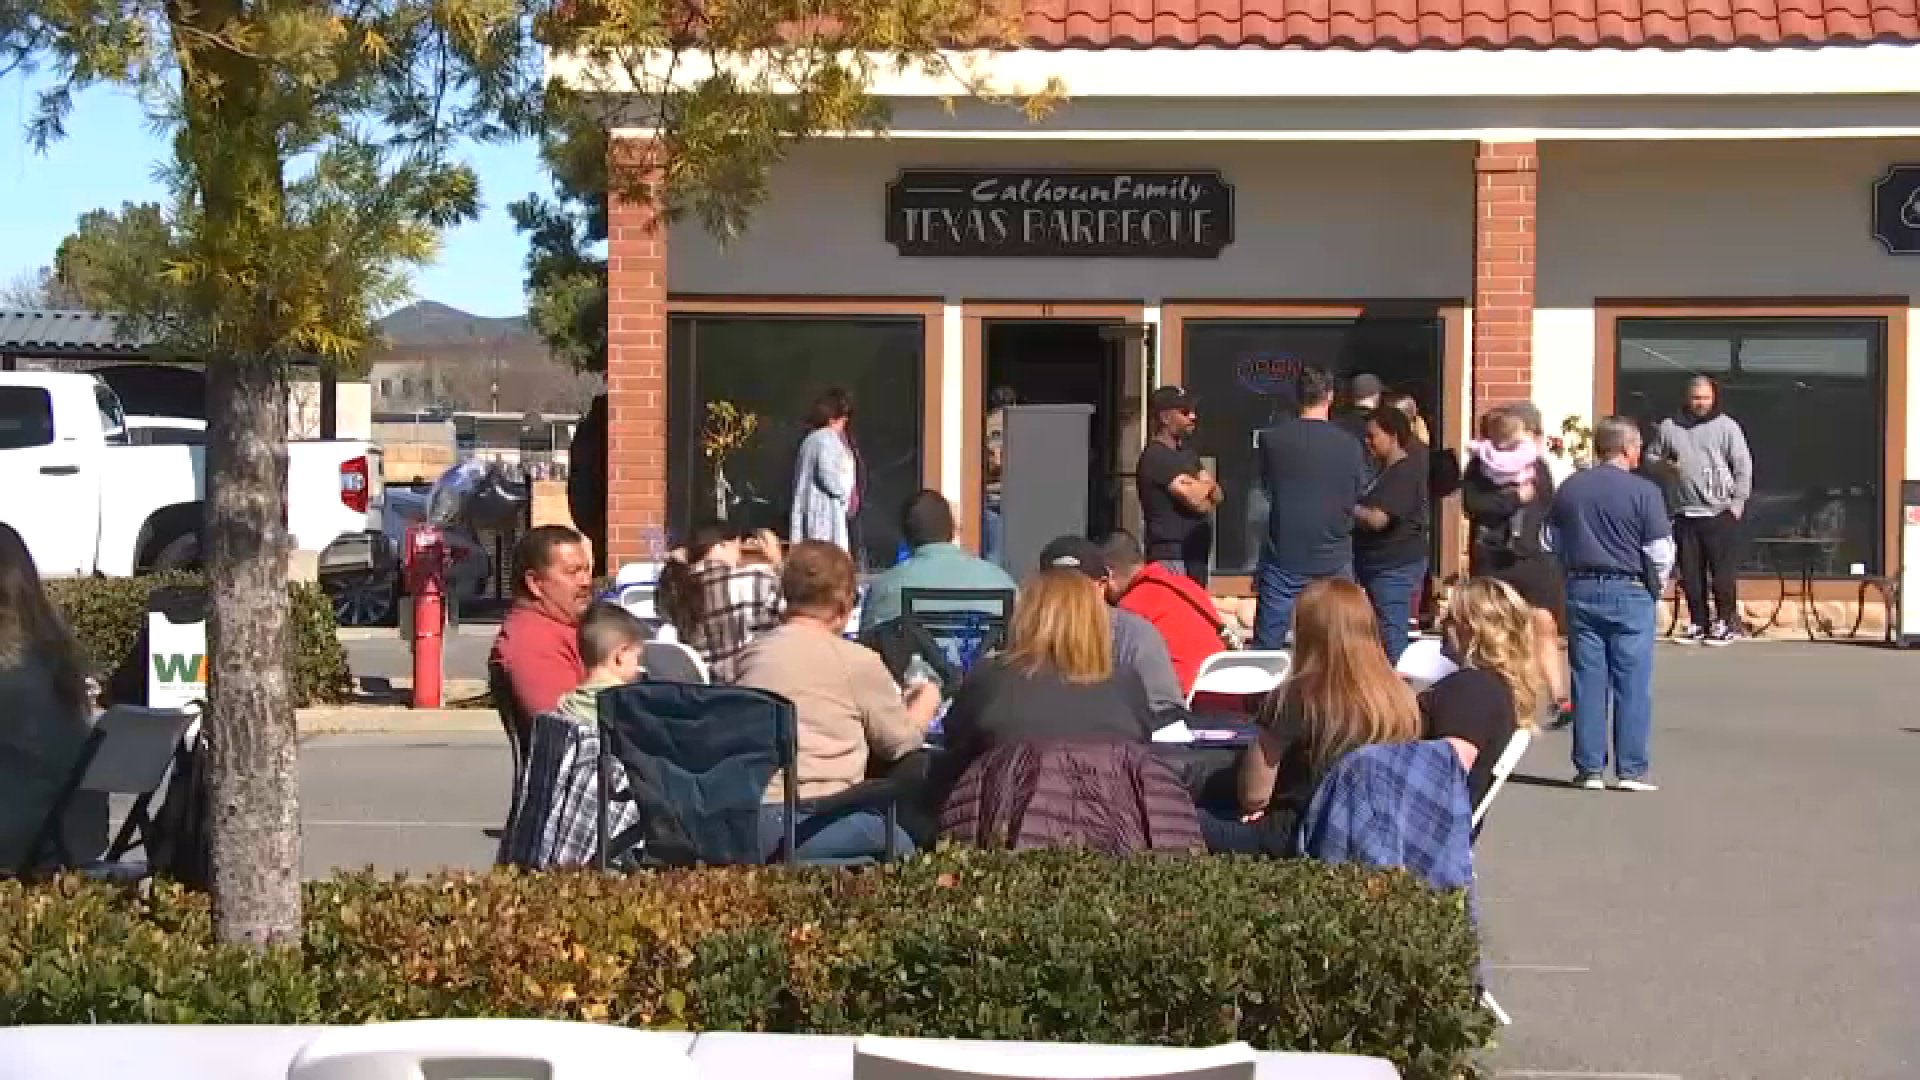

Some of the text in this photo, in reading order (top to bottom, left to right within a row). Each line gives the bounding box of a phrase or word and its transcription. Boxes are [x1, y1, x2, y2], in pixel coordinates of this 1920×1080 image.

[970, 175, 1201, 205] Calhoun Family
[903, 207, 1213, 245] TEXAS BARBEQUE
